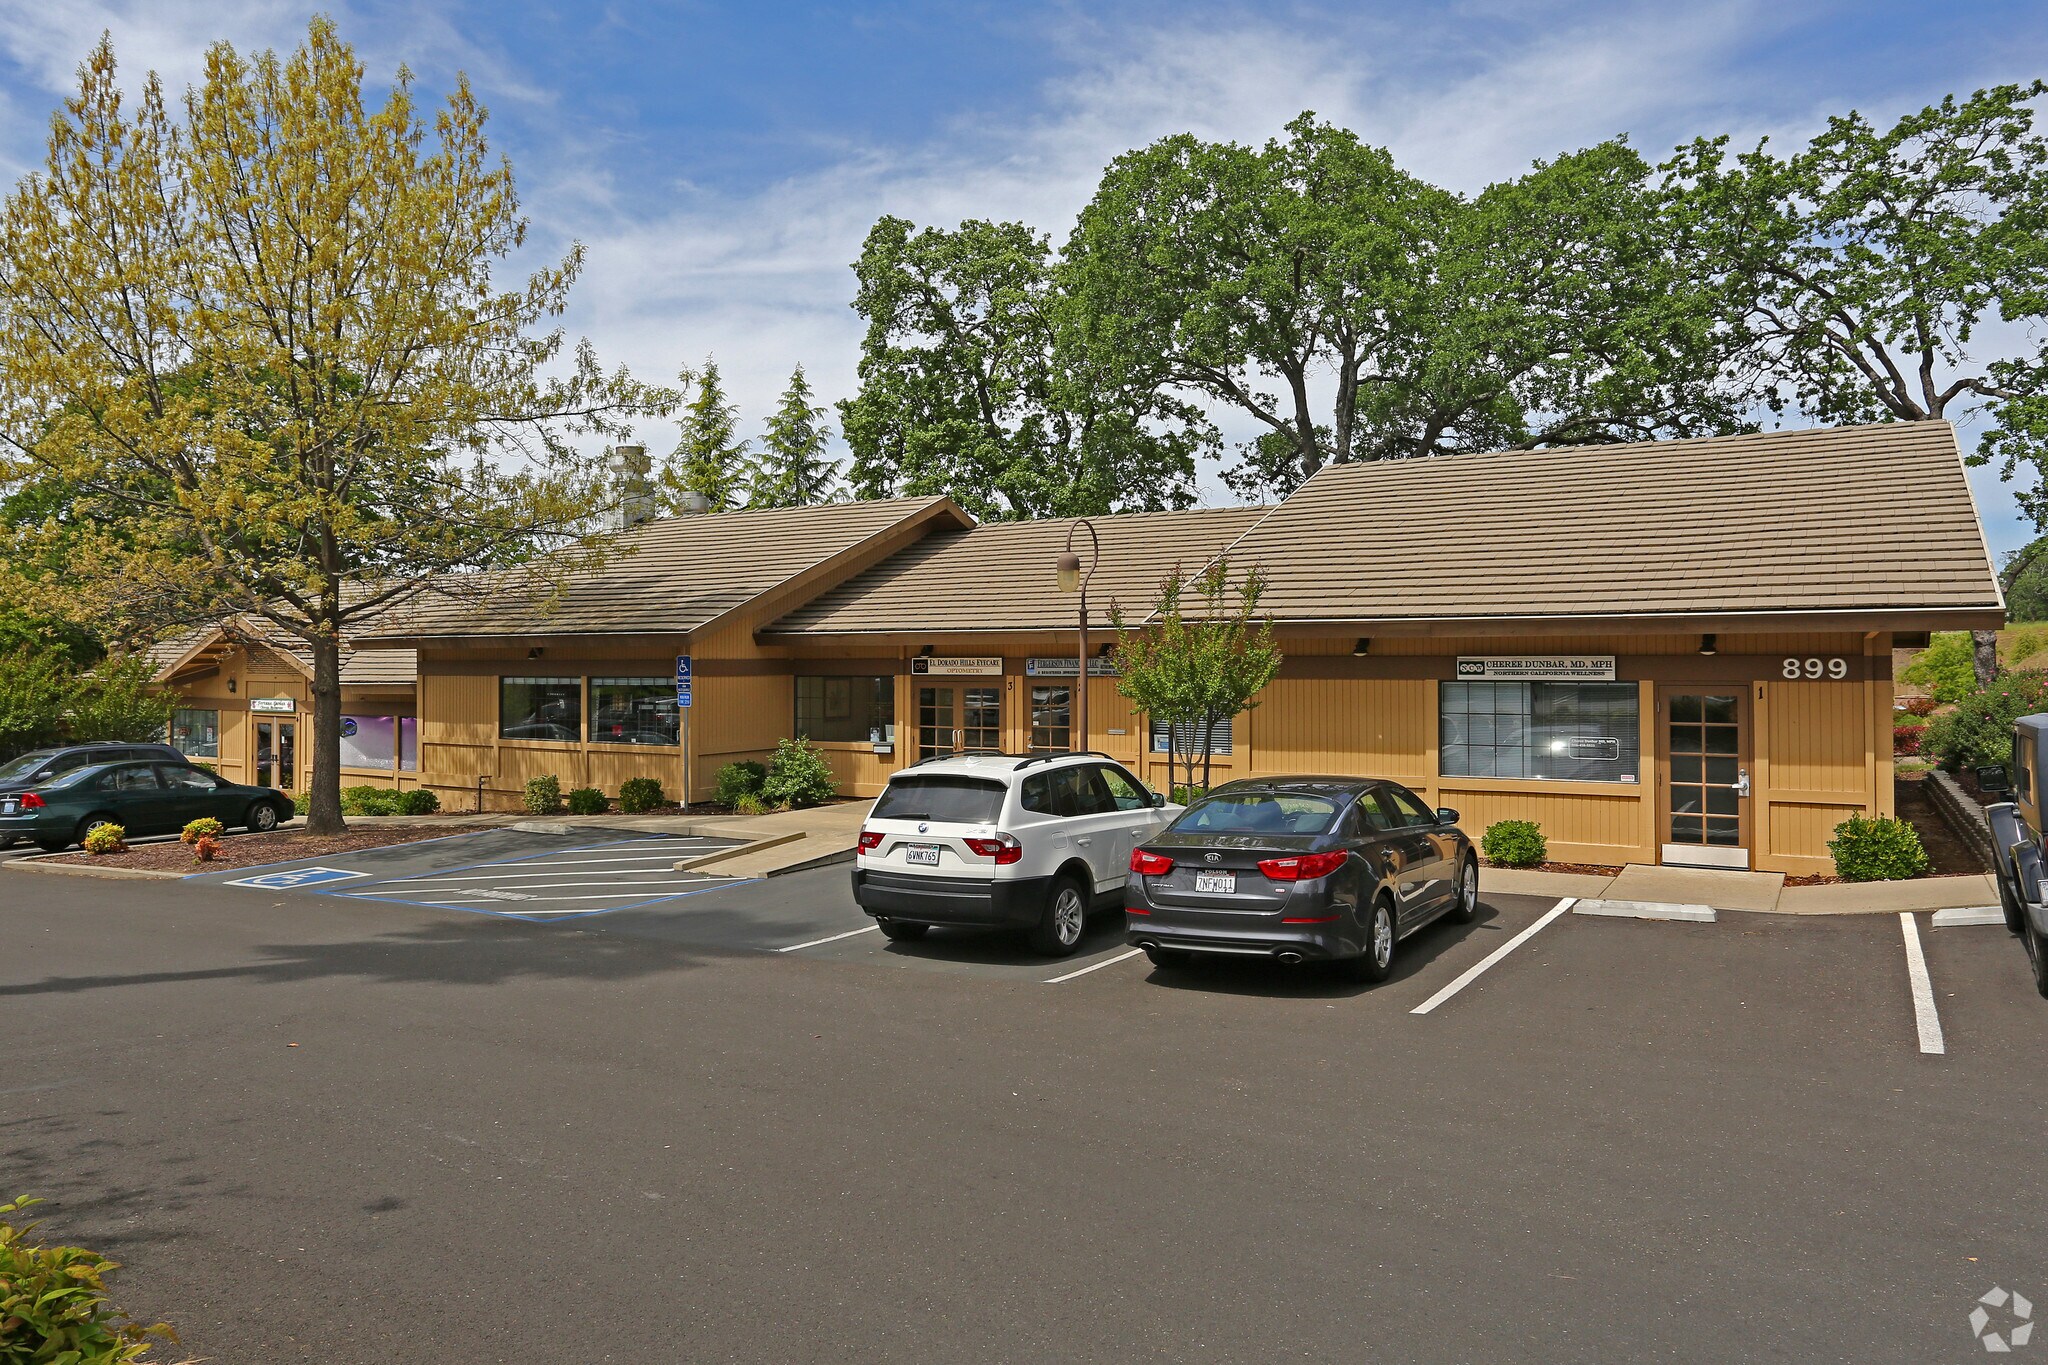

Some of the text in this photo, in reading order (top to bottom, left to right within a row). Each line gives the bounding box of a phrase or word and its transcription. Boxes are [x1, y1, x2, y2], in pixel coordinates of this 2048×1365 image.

[1486, 660, 1613, 669] CHEREE DUNBAR, MD, MPH
[1782, 658, 1848, 679] 899
[1008, 681, 1013, 691] 3
[1758, 686, 1763, 700] 1
[908, 850, 937, 861] 6VNK765
